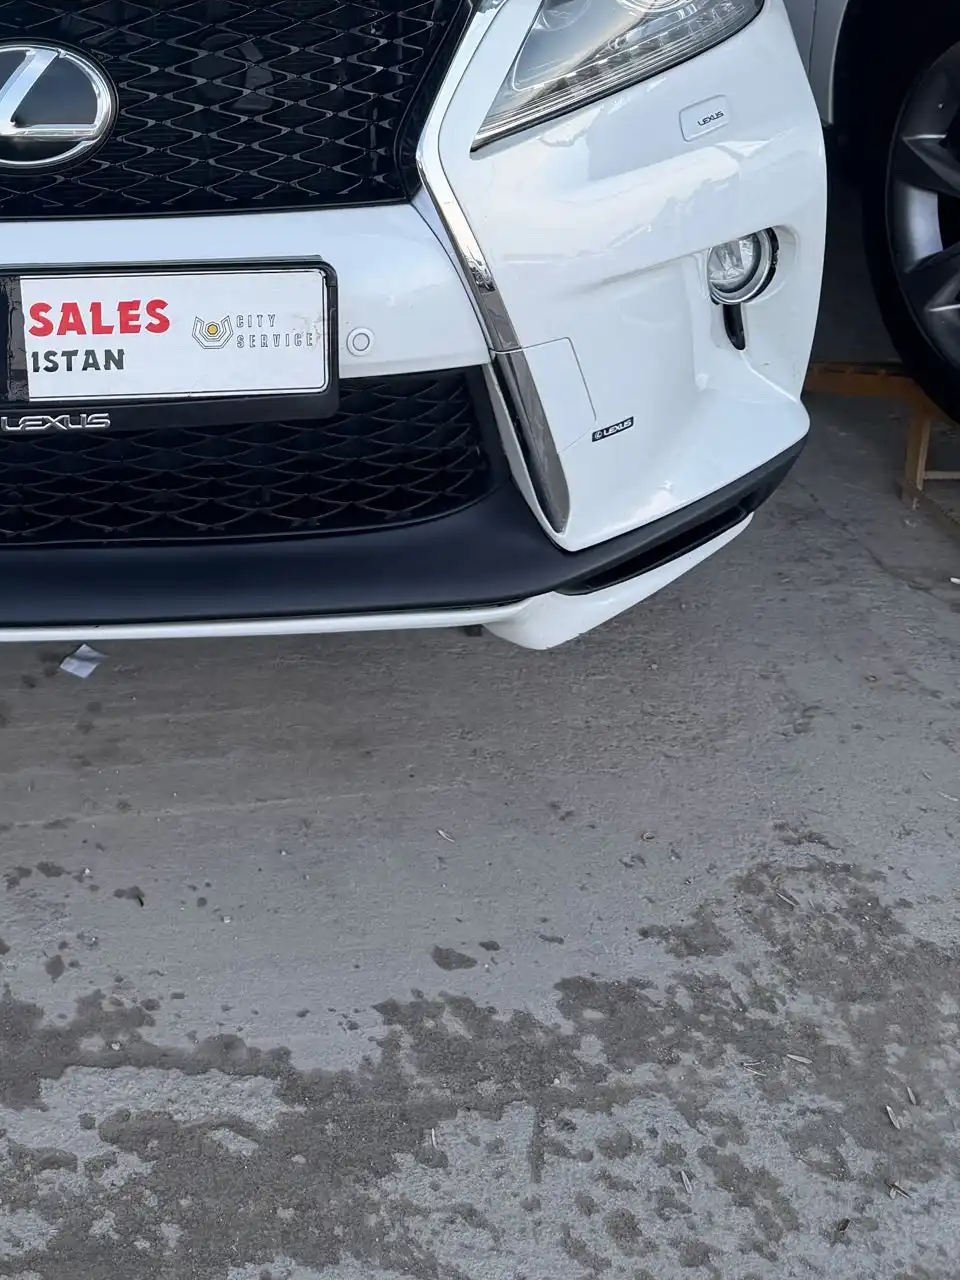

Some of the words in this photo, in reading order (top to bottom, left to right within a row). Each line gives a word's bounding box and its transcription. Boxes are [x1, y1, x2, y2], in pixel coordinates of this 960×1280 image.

[697, 110, 724, 126] LEXUS
[28, 298, 171, 337] SALES
[236, 314, 276, 328] CITY
[236, 332, 314, 348] SERVICE
[1, 412, 111, 431] LEXUS
[603, 419, 632, 436] LEXUS
